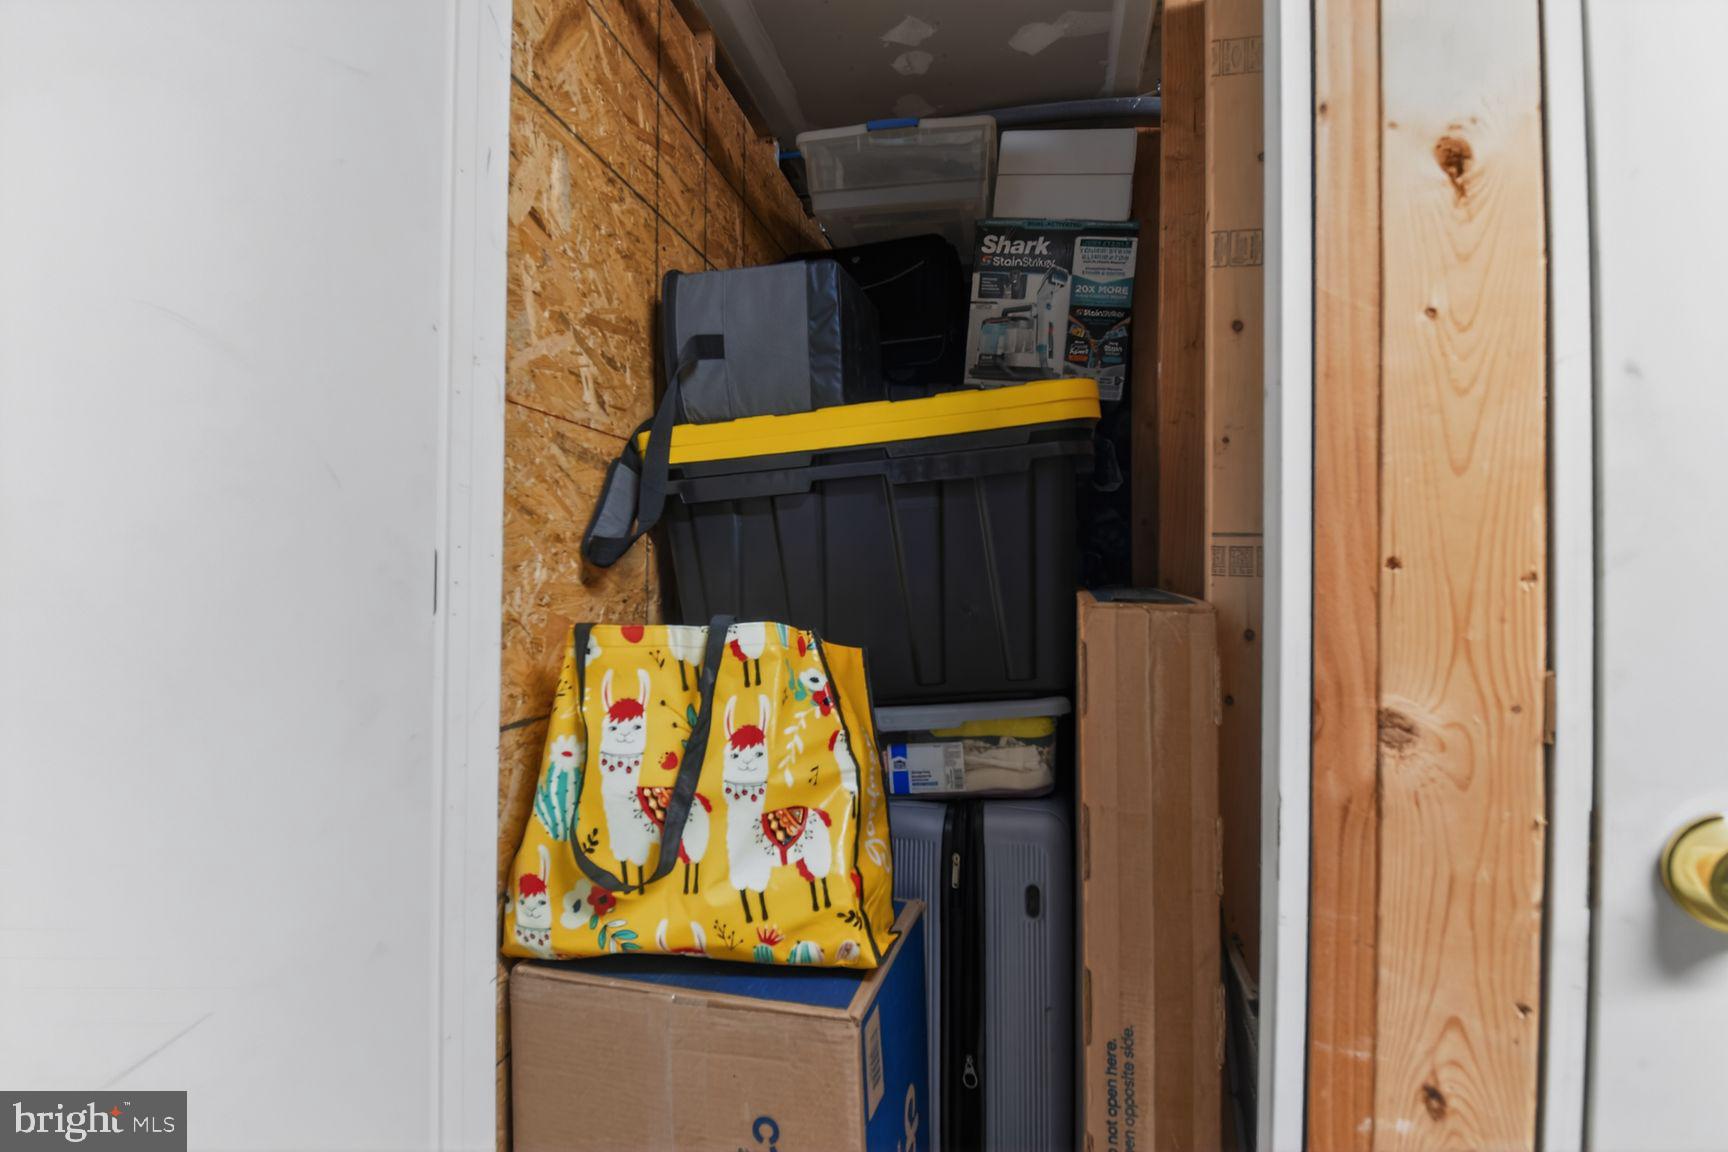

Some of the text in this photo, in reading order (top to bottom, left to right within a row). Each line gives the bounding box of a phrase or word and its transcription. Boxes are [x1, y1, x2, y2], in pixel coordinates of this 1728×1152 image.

[981, 234, 1051, 255] Shark
[1074, 284, 1129, 295] 20X MORE
[1105, 1038, 1118, 1076] here.
[1120, 1025, 1135, 1060] side.
[1107, 1078, 1121, 1118] open
[1121, 1061, 1138, 1128] opposite
[1106, 1119, 1118, 1149] not
